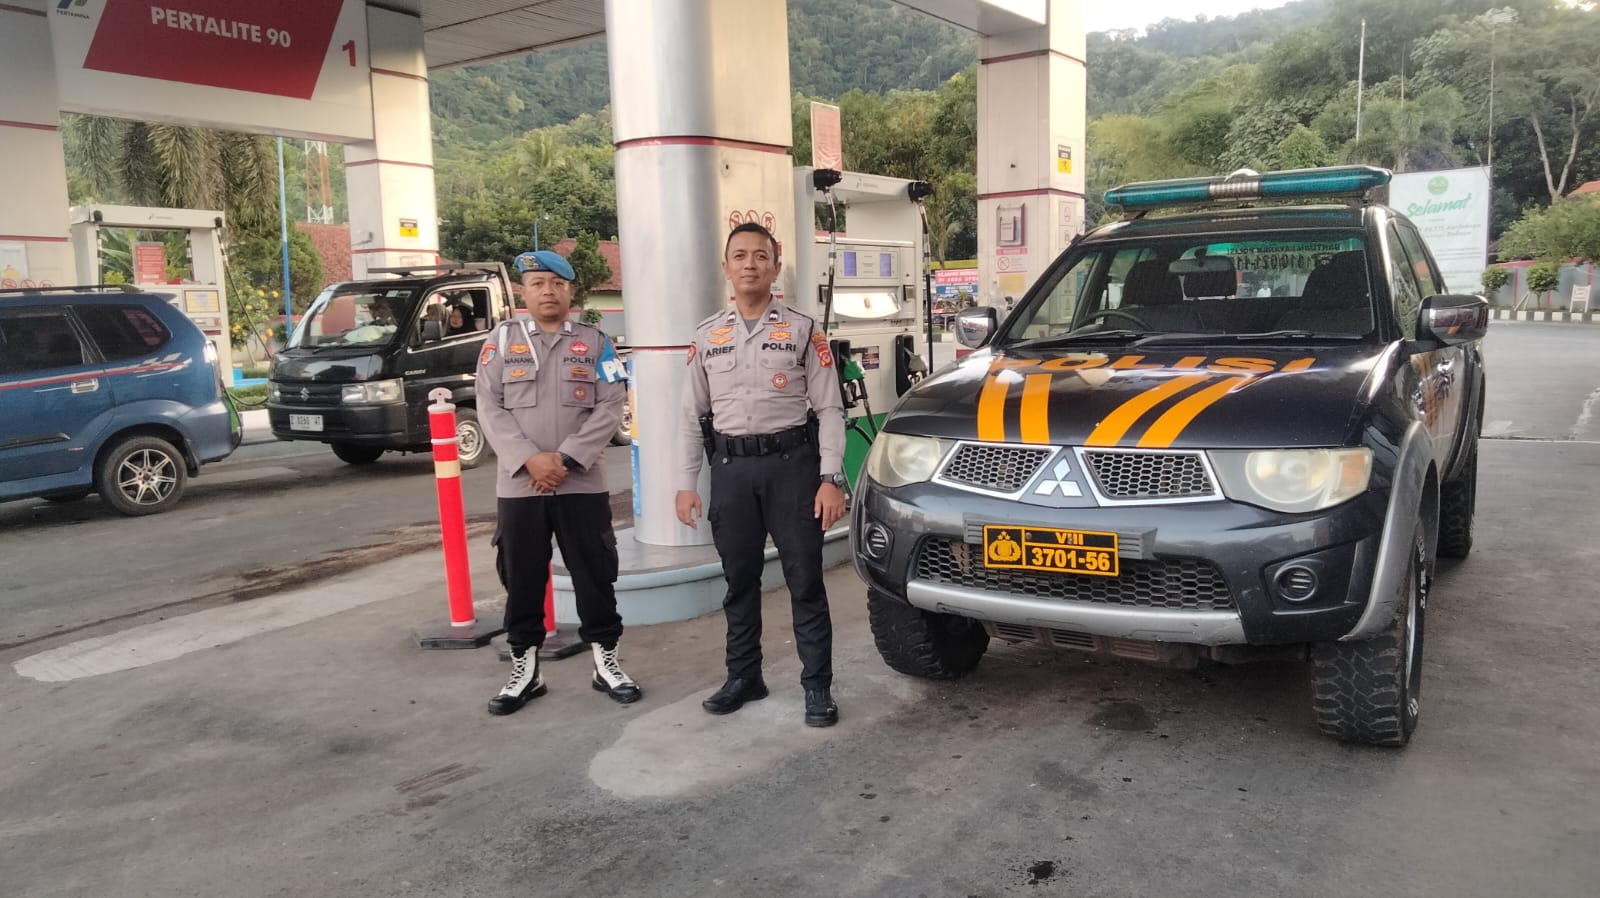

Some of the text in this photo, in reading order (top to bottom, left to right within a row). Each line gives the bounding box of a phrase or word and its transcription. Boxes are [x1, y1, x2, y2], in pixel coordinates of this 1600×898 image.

[151, 6, 291, 48] PERTALITE 90
[341, 39, 357, 68] 1
[1406, 192, 1473, 217] Selamat
[705, 345, 735, 358] ARIEF
[762, 342, 797, 352] POLRI
[504, 357, 535, 365] NANANG
[563, 356, 595, 365] POLRI
[990, 354, 1317, 372] POLISI
[1055, 531, 1084, 546] VIII
[1031, 547, 1111, 572] 3701-56
